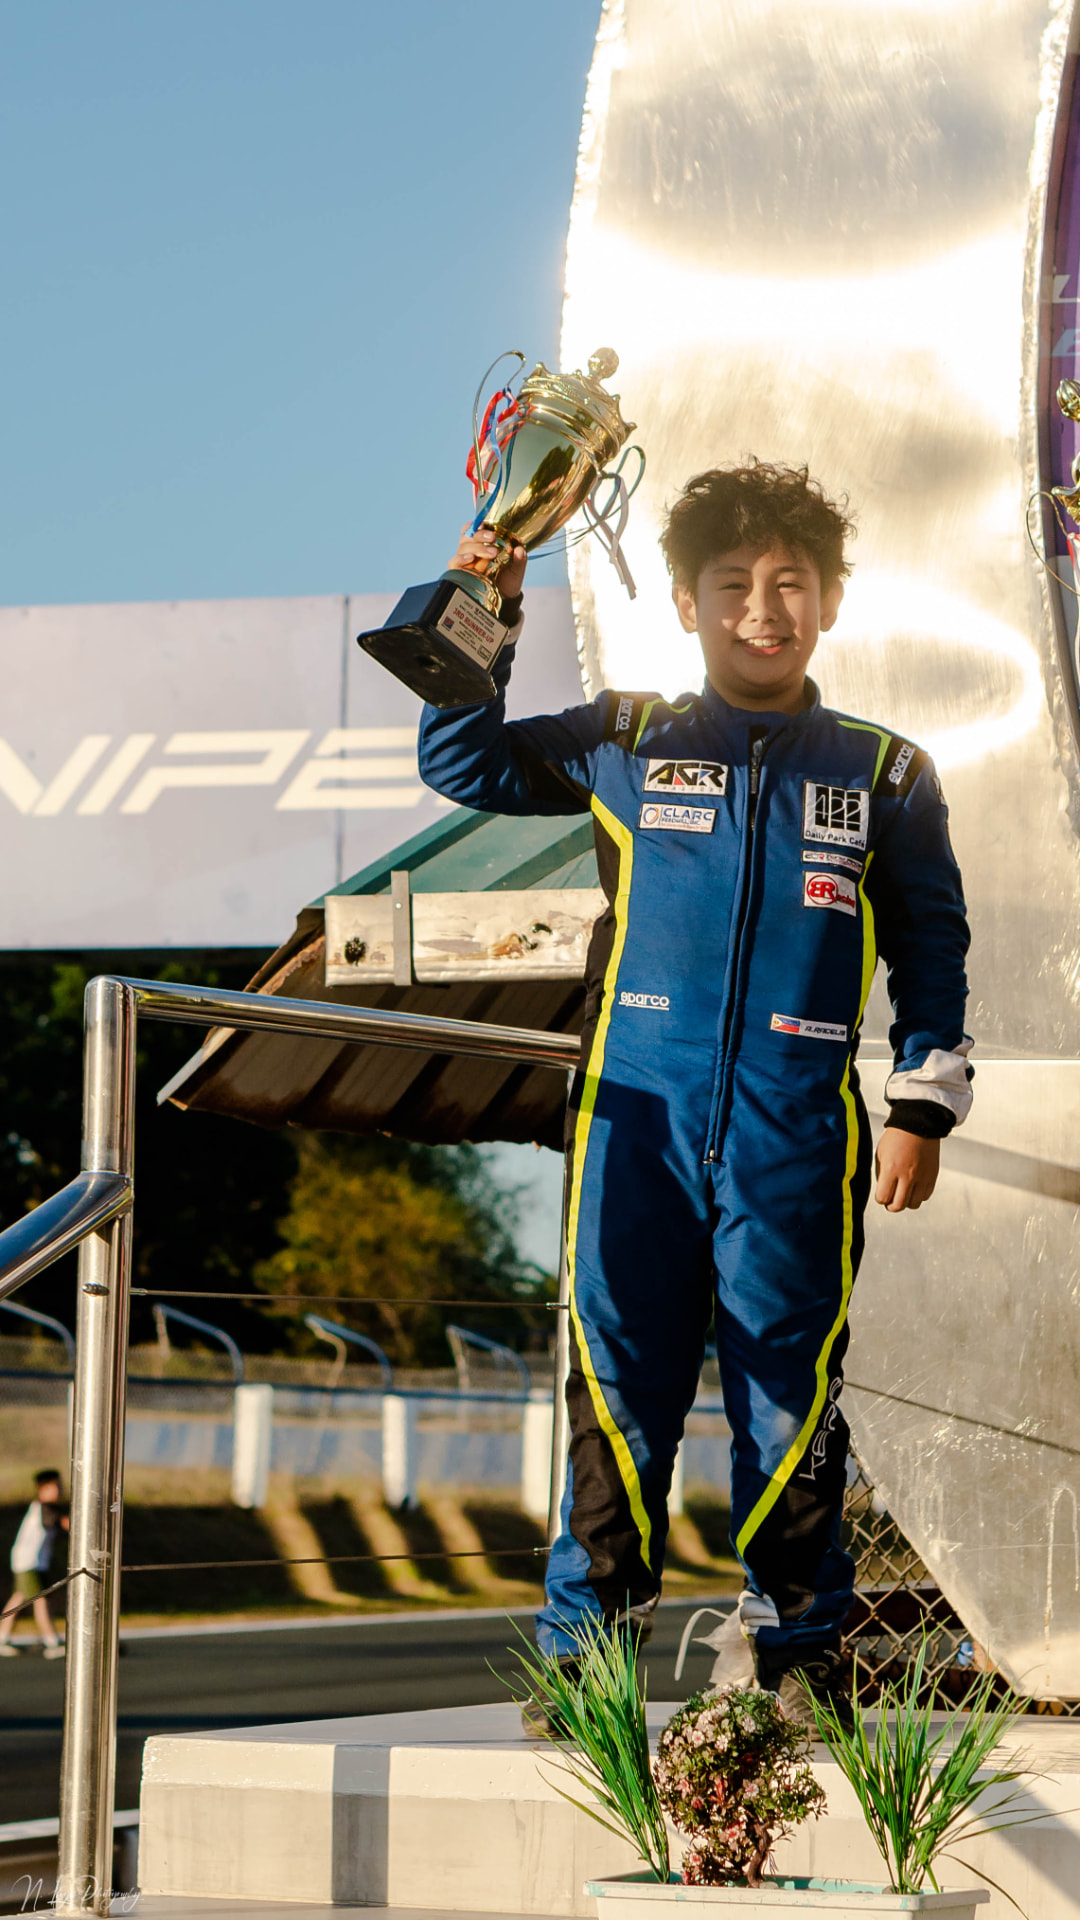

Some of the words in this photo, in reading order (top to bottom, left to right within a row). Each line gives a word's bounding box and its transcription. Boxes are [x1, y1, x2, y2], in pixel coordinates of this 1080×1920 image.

[888, 743, 916, 786] sparco
[663, 807, 713, 821] CLARC
[805, 830, 825, 841] Daily
[828, 833, 847, 844] Park
[618, 991, 670, 1012] sparco
